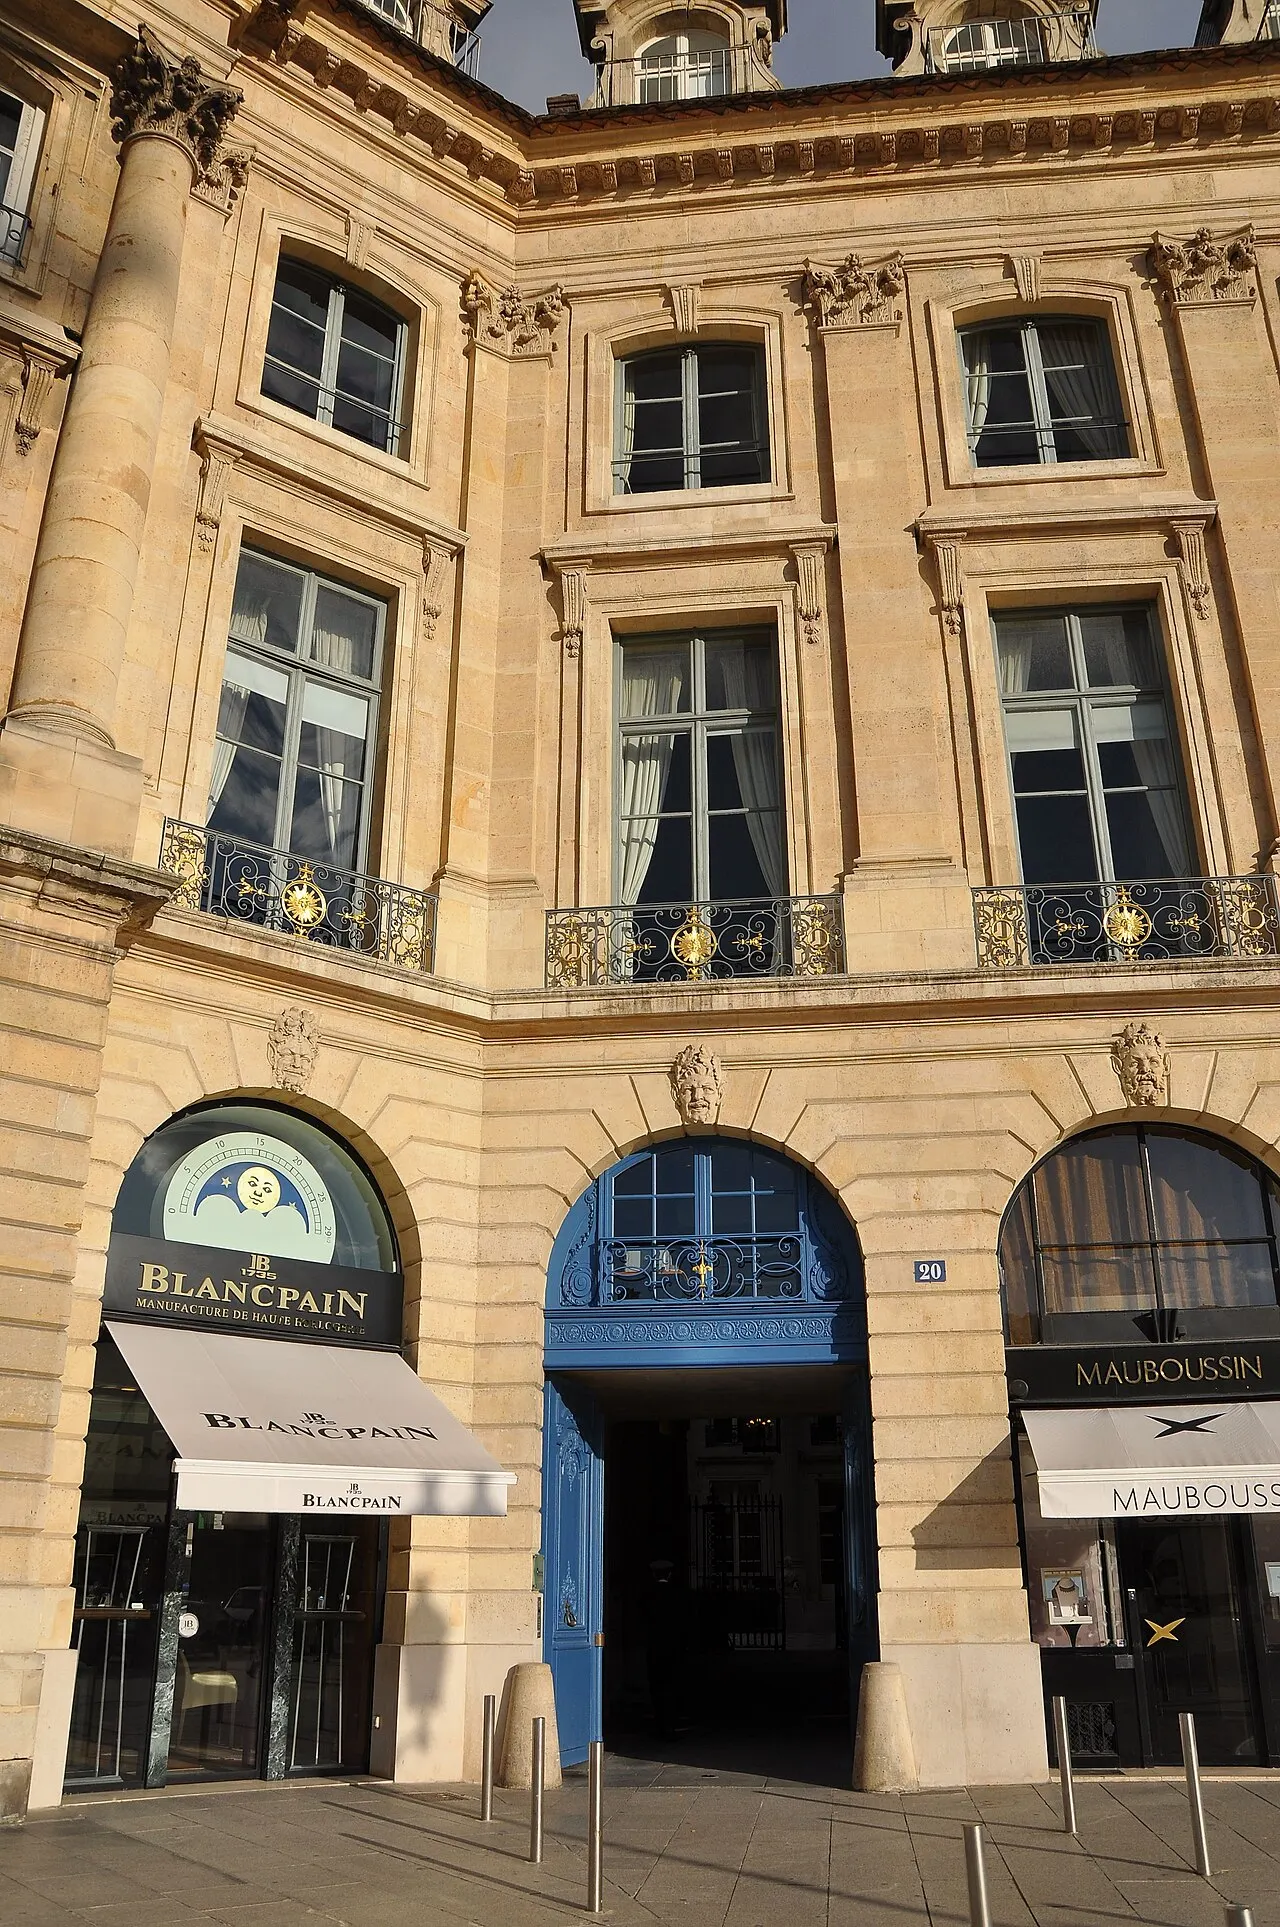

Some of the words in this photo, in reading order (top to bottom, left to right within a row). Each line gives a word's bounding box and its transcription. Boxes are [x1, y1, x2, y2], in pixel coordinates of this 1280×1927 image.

[183, 1165, 191, 1175] 5
[214, 1139, 226, 1150] 10
[256, 1137, 265, 1147] 15
[292, 1155, 304, 1167] 20
[317, 1191, 327, 1204] 25
[241, 1269, 278, 1281] 1735
[919, 1262, 942, 1280] 20
[137, 1261, 369, 1320] BLANCPAIN
[135, 1297, 229, 1319] MANUFACTURE
[232, 1309, 250, 1322] DE
[252, 1311, 291, 1326] HAUTE
[1076, 1355, 1263, 1386] MAUBOUSSIN
[199, 1412, 439, 1441] BLANCPAIN
[302, 1493, 402, 1509] BLANCPAIN
